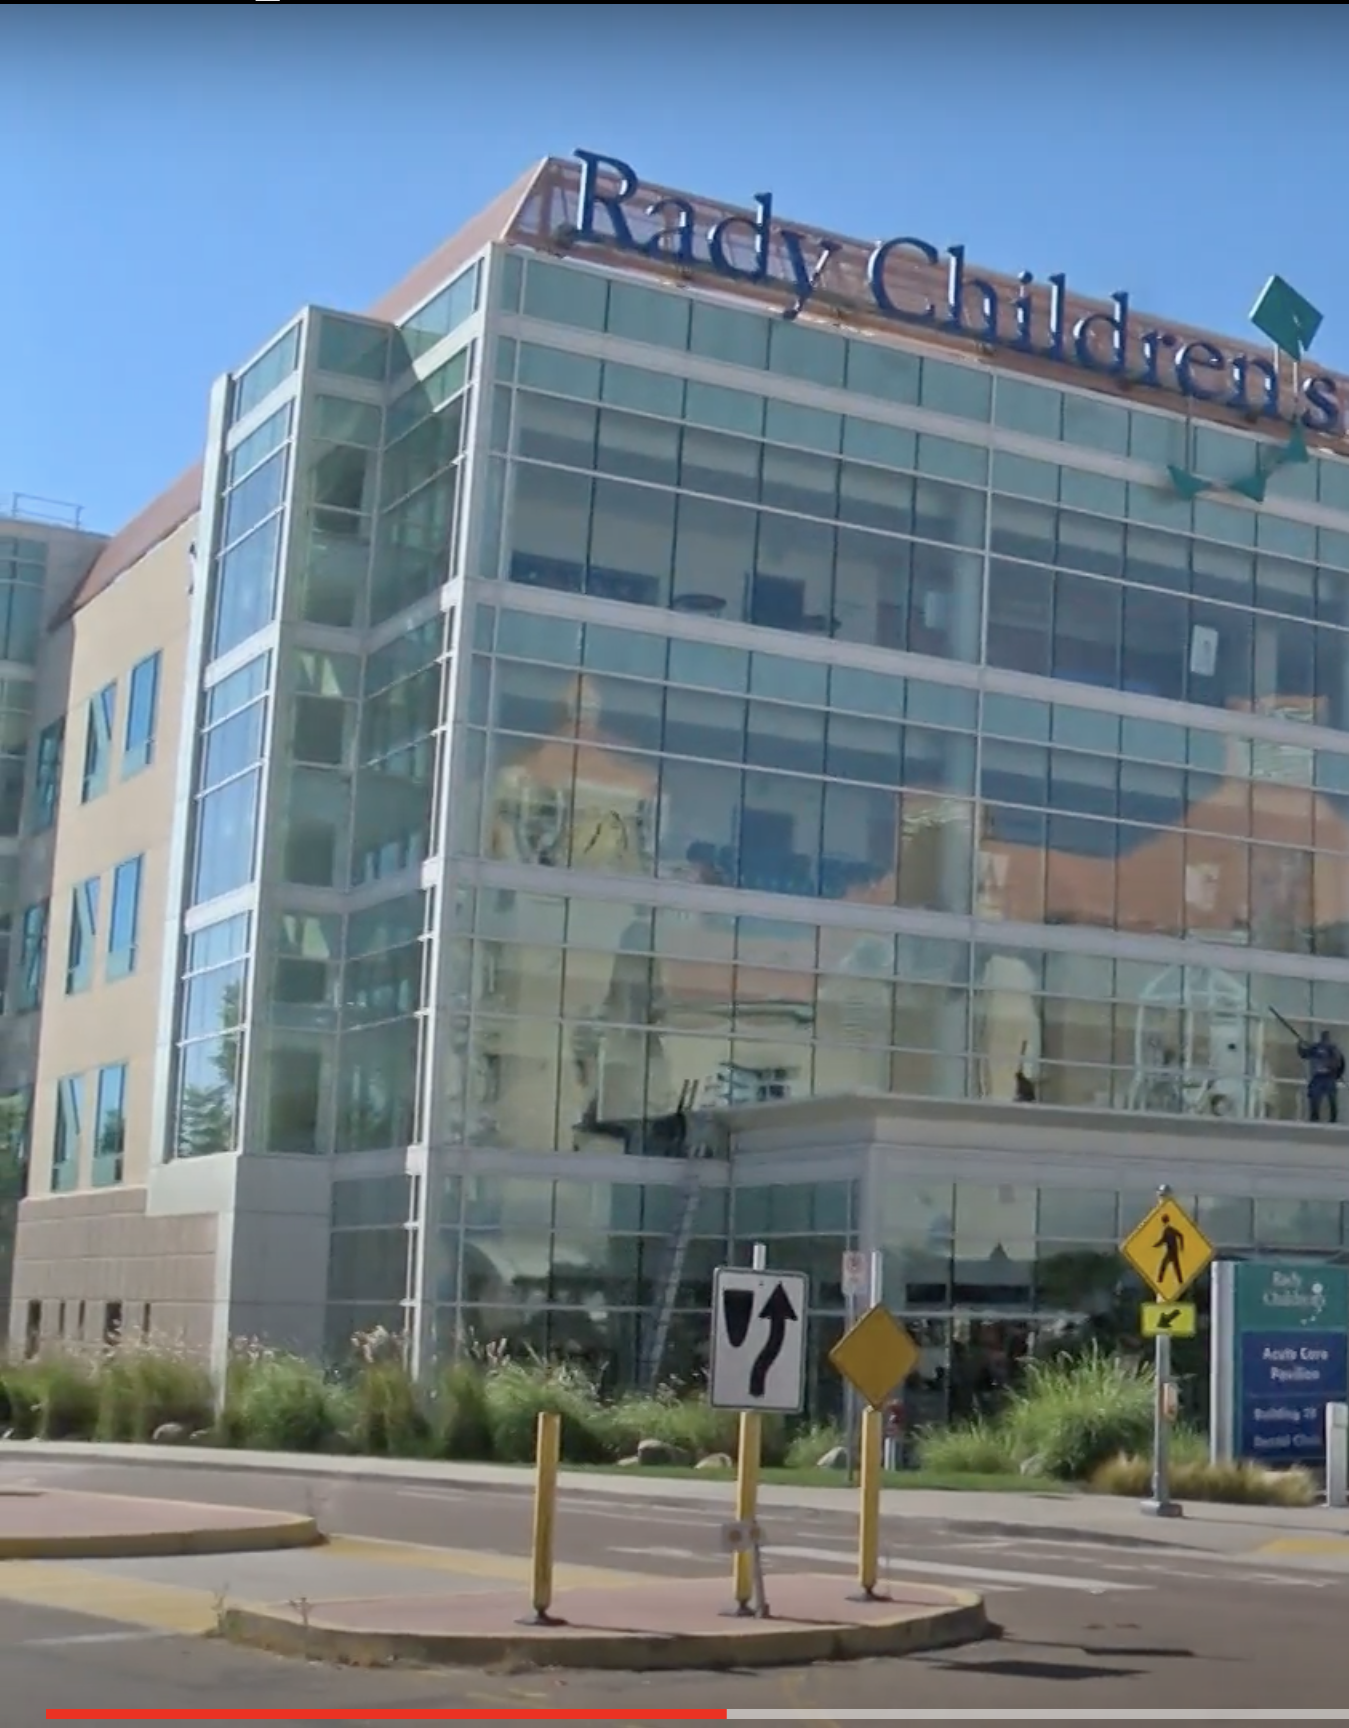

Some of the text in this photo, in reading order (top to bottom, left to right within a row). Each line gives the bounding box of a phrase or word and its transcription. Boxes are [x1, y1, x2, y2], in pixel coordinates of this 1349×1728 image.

[573, 148, 843, 320] Rady
[1263, 1347, 1329, 1360] Acute Care
[1270, 1366, 1320, 1380] Pavilion
